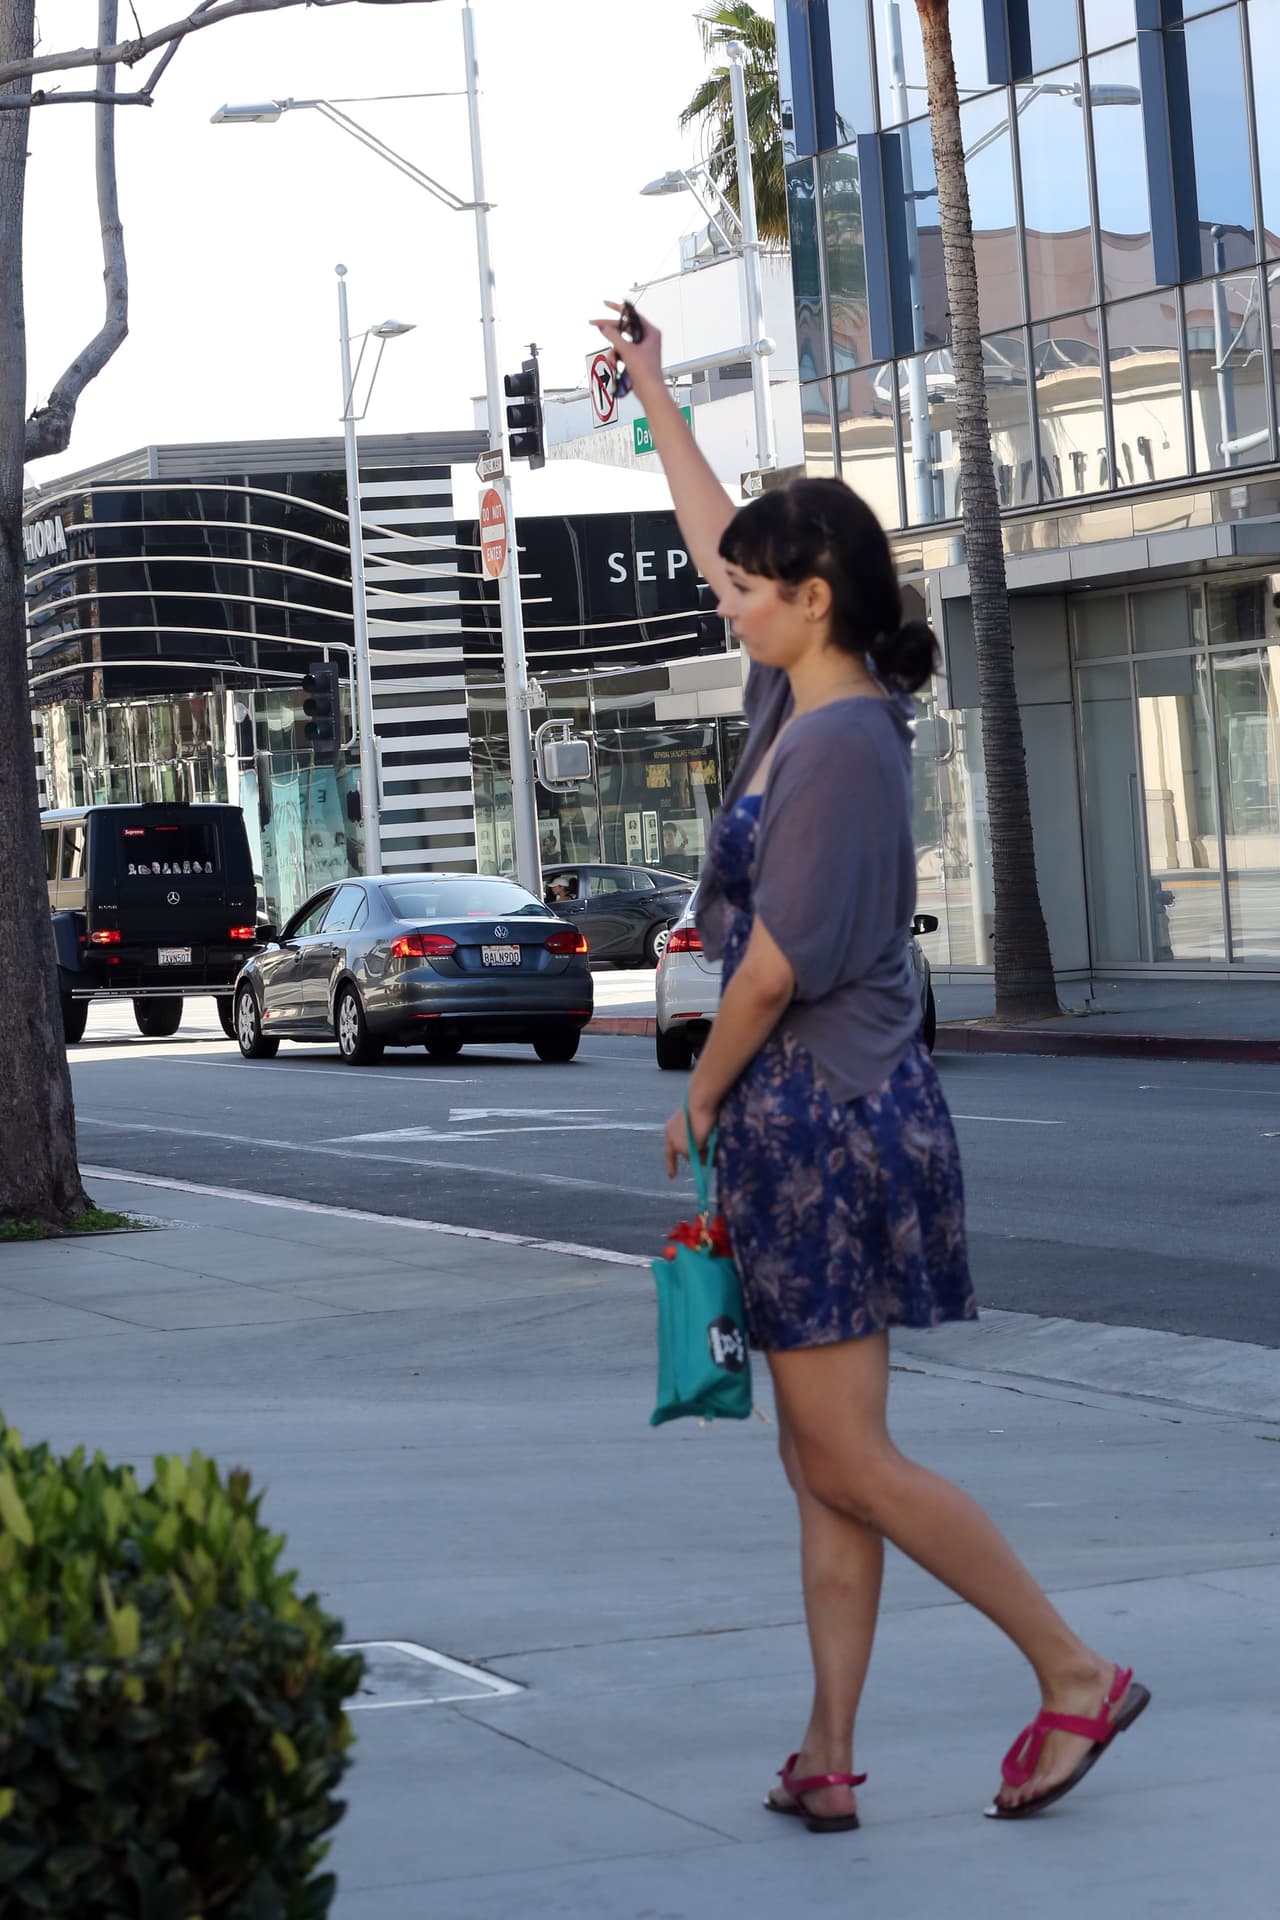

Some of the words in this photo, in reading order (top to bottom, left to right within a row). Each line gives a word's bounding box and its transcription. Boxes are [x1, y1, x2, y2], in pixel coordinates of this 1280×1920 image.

[482, 507, 490, 521] DO
[492, 504, 502, 520] NOT
[22, 515, 67, 560] HORA
[487, 545, 502, 562] ENTER
[607, 549, 704, 582] SEP
[485, 952, 519, 962] 8ALN900
